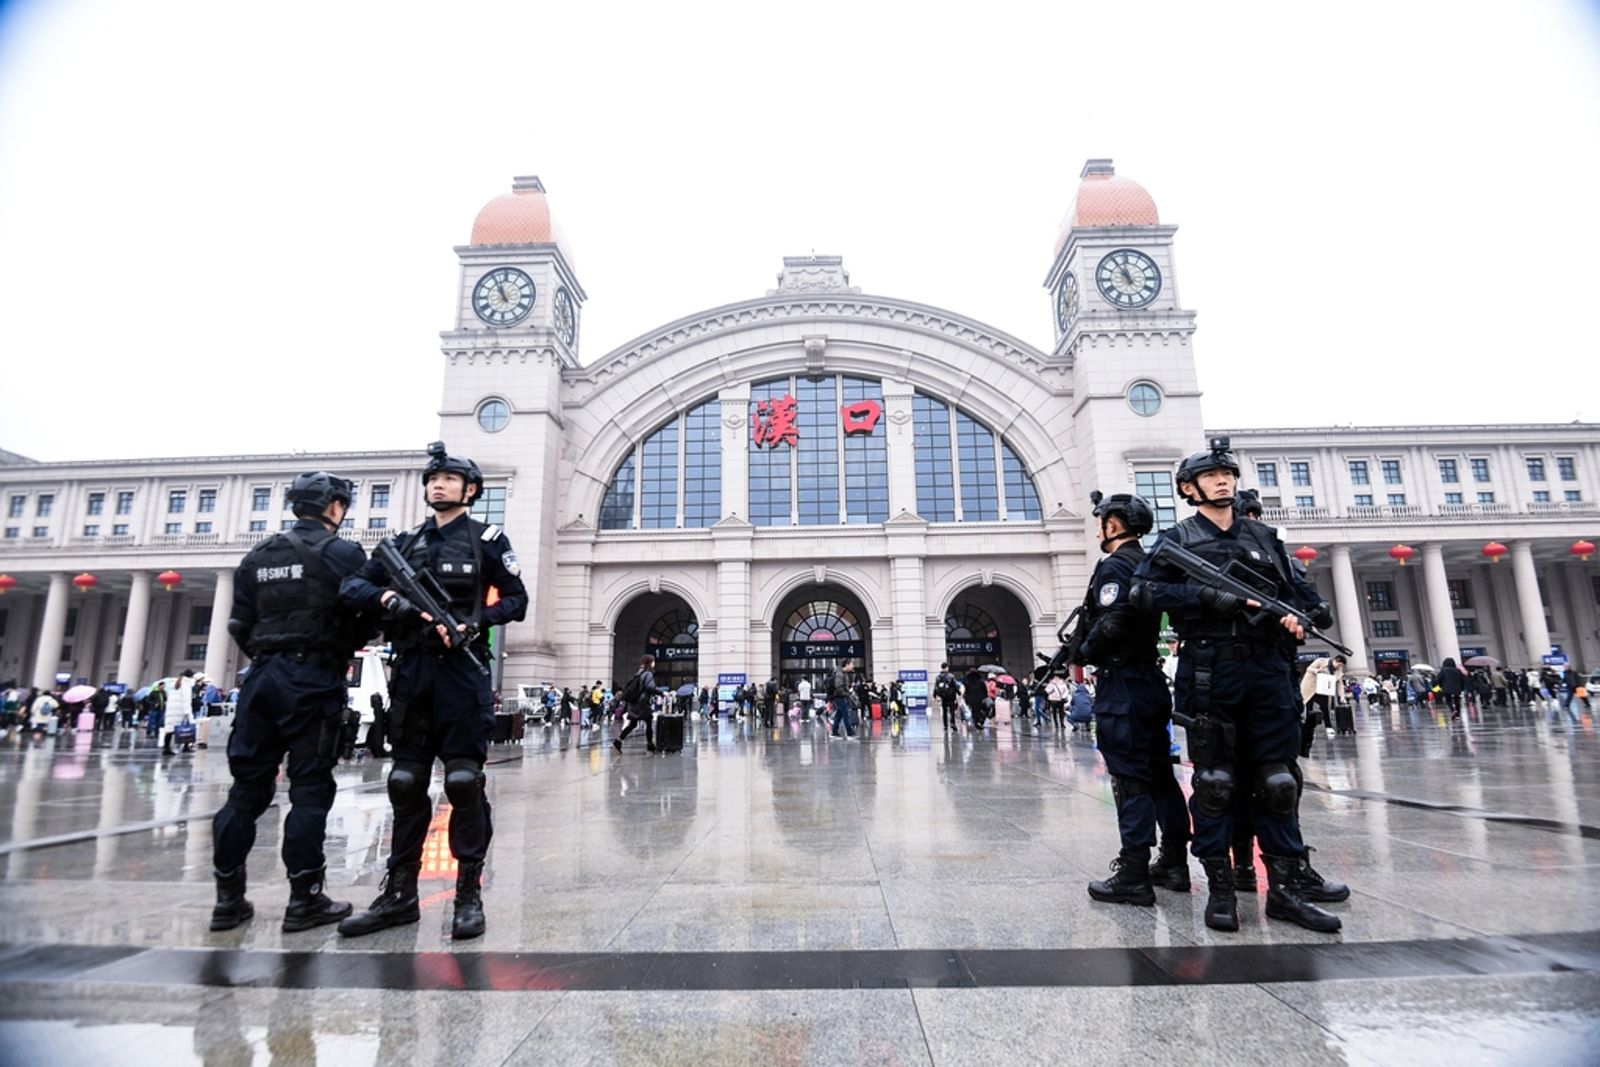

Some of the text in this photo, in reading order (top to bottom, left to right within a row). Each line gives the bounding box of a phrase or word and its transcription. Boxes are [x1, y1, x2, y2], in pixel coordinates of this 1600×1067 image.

[752, 394, 882, 449] 漢口
[790, 646, 798, 656] 3
[847, 645, 854, 654] 4
